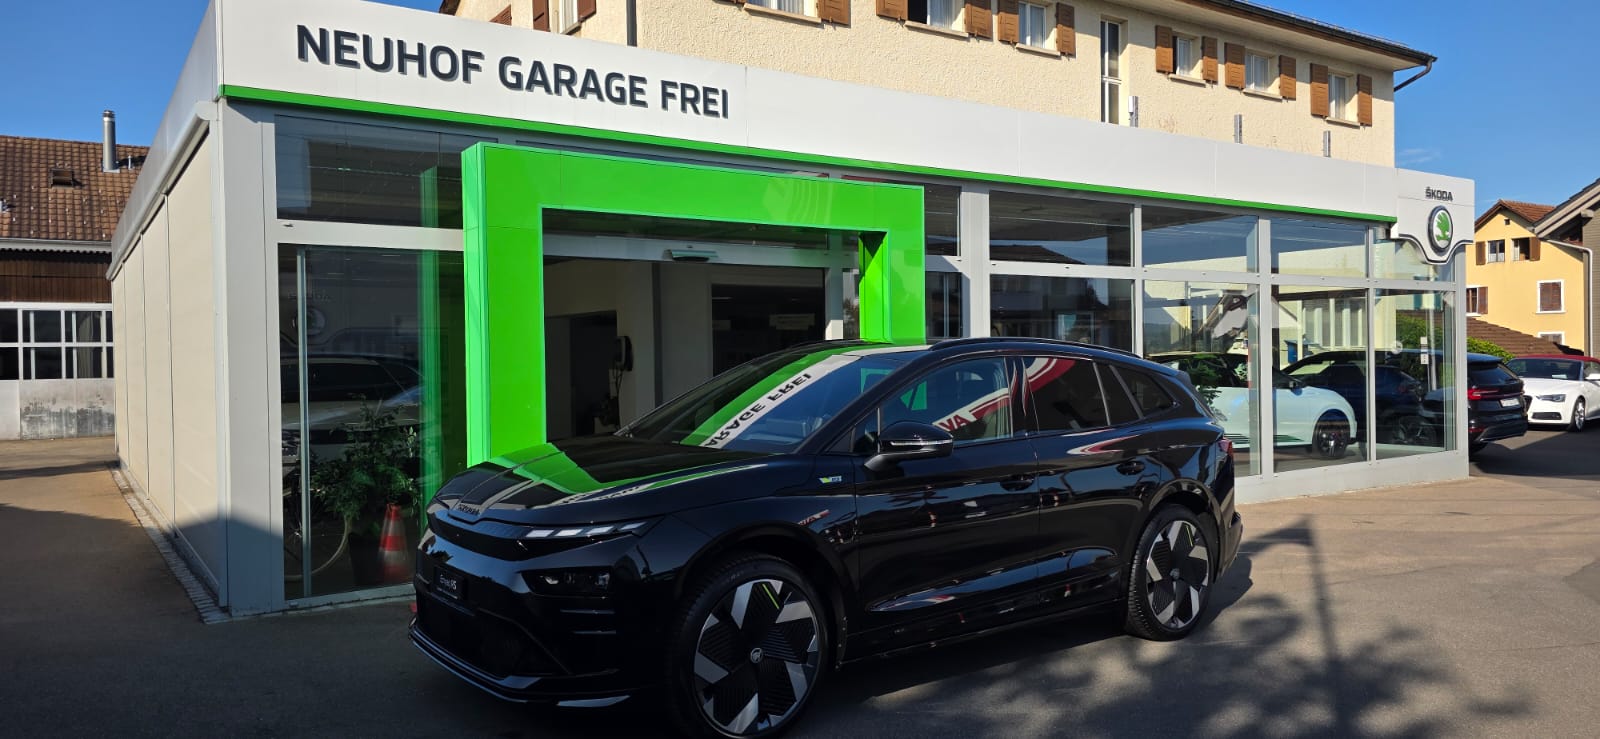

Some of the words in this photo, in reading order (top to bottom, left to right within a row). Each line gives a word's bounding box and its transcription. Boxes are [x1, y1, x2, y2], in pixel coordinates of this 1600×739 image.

[296, 24, 485, 84] NEUHOF
[498, 55, 649, 108] GARAGE
[660, 79, 729, 119] FREI
[1425, 187, 1453, 201] ŠKODA
